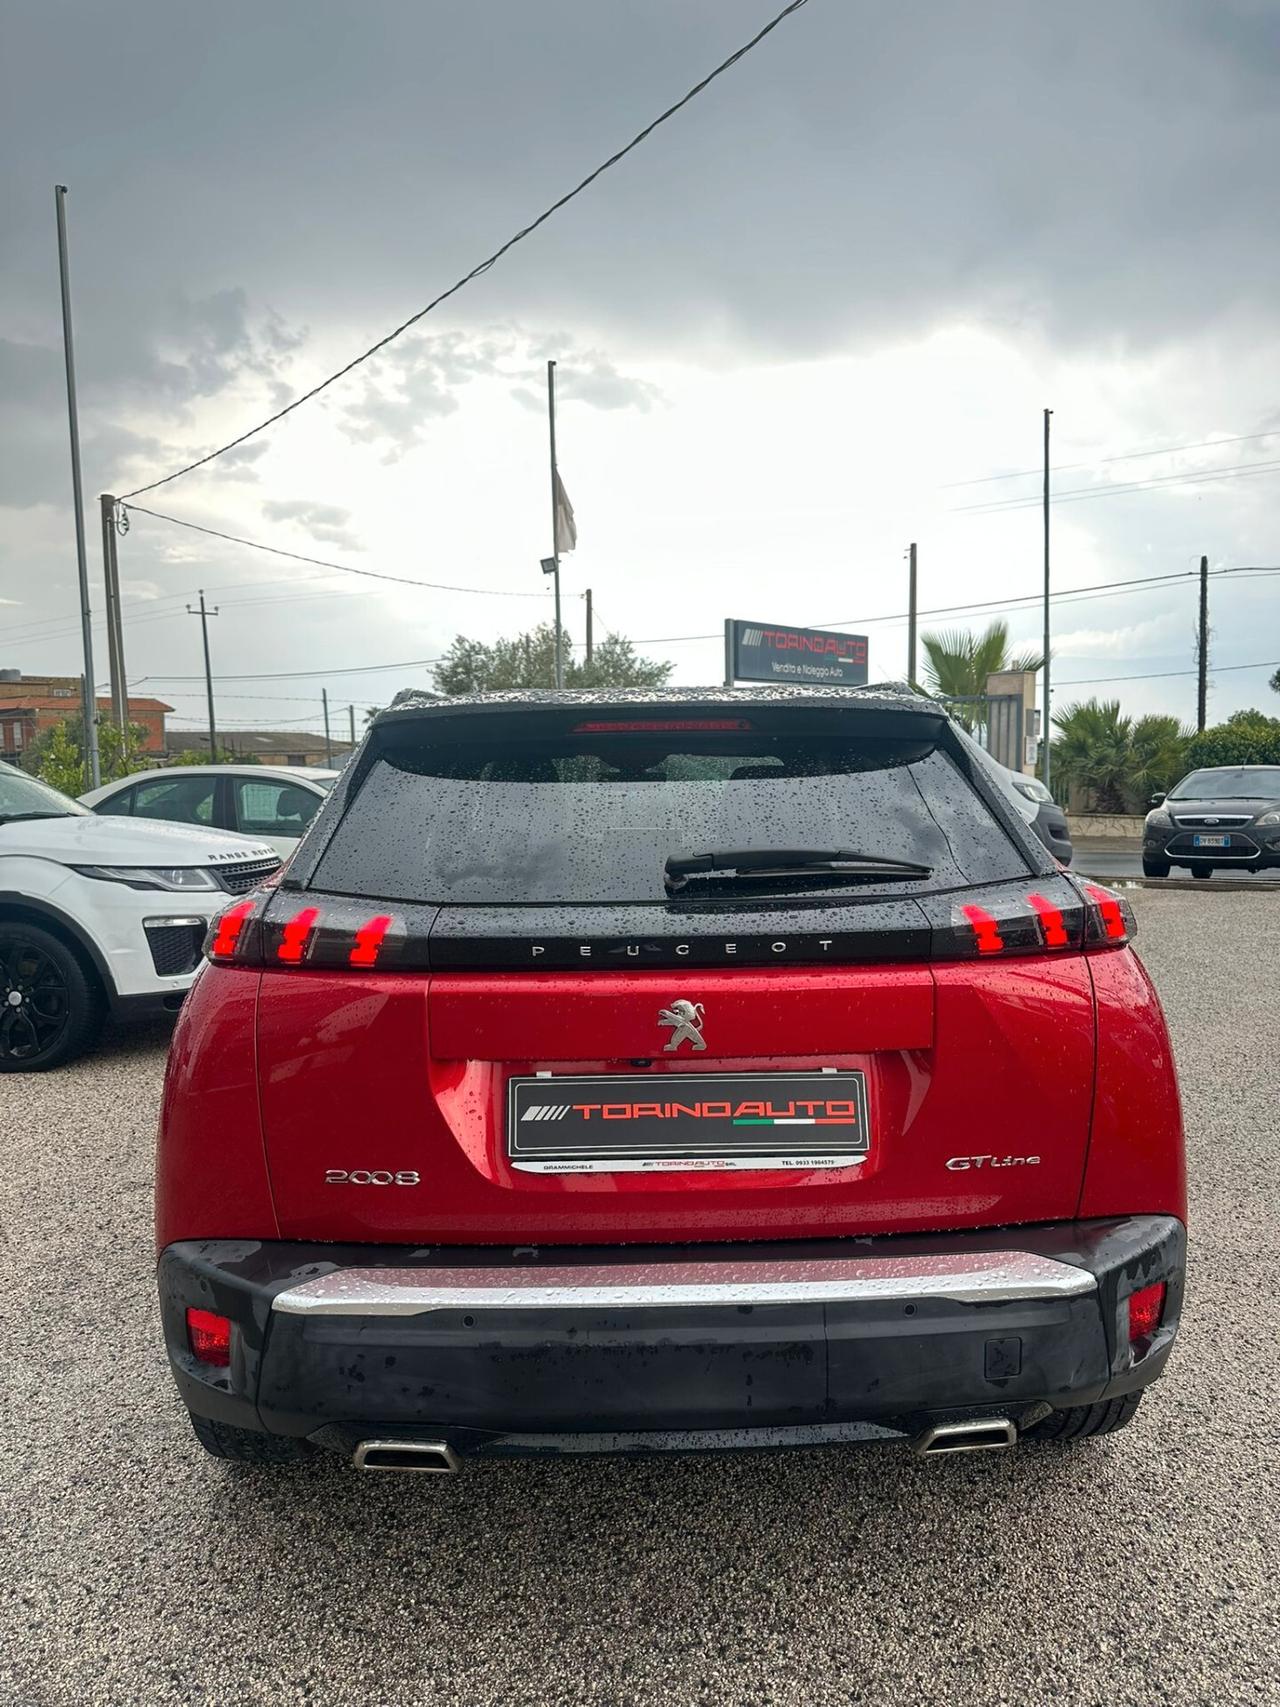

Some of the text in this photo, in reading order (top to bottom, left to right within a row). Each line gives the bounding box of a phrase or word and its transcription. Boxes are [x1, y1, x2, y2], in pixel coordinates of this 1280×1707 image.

[763, 631, 866, 657] TORINOAUTO
[771, 661, 796, 674] Vendita
[802, 664, 830, 678] Noleggio
[830, 666, 843, 678] Auto
[208, 851, 248, 861] RANGE
[531, 940, 833, 957] PEUGEOT
[573, 1101, 855, 1120] TORINOAUTO
[655, 1160, 725, 1168] TORINOAUTO
[325, 1169, 421, 1186] 2008
